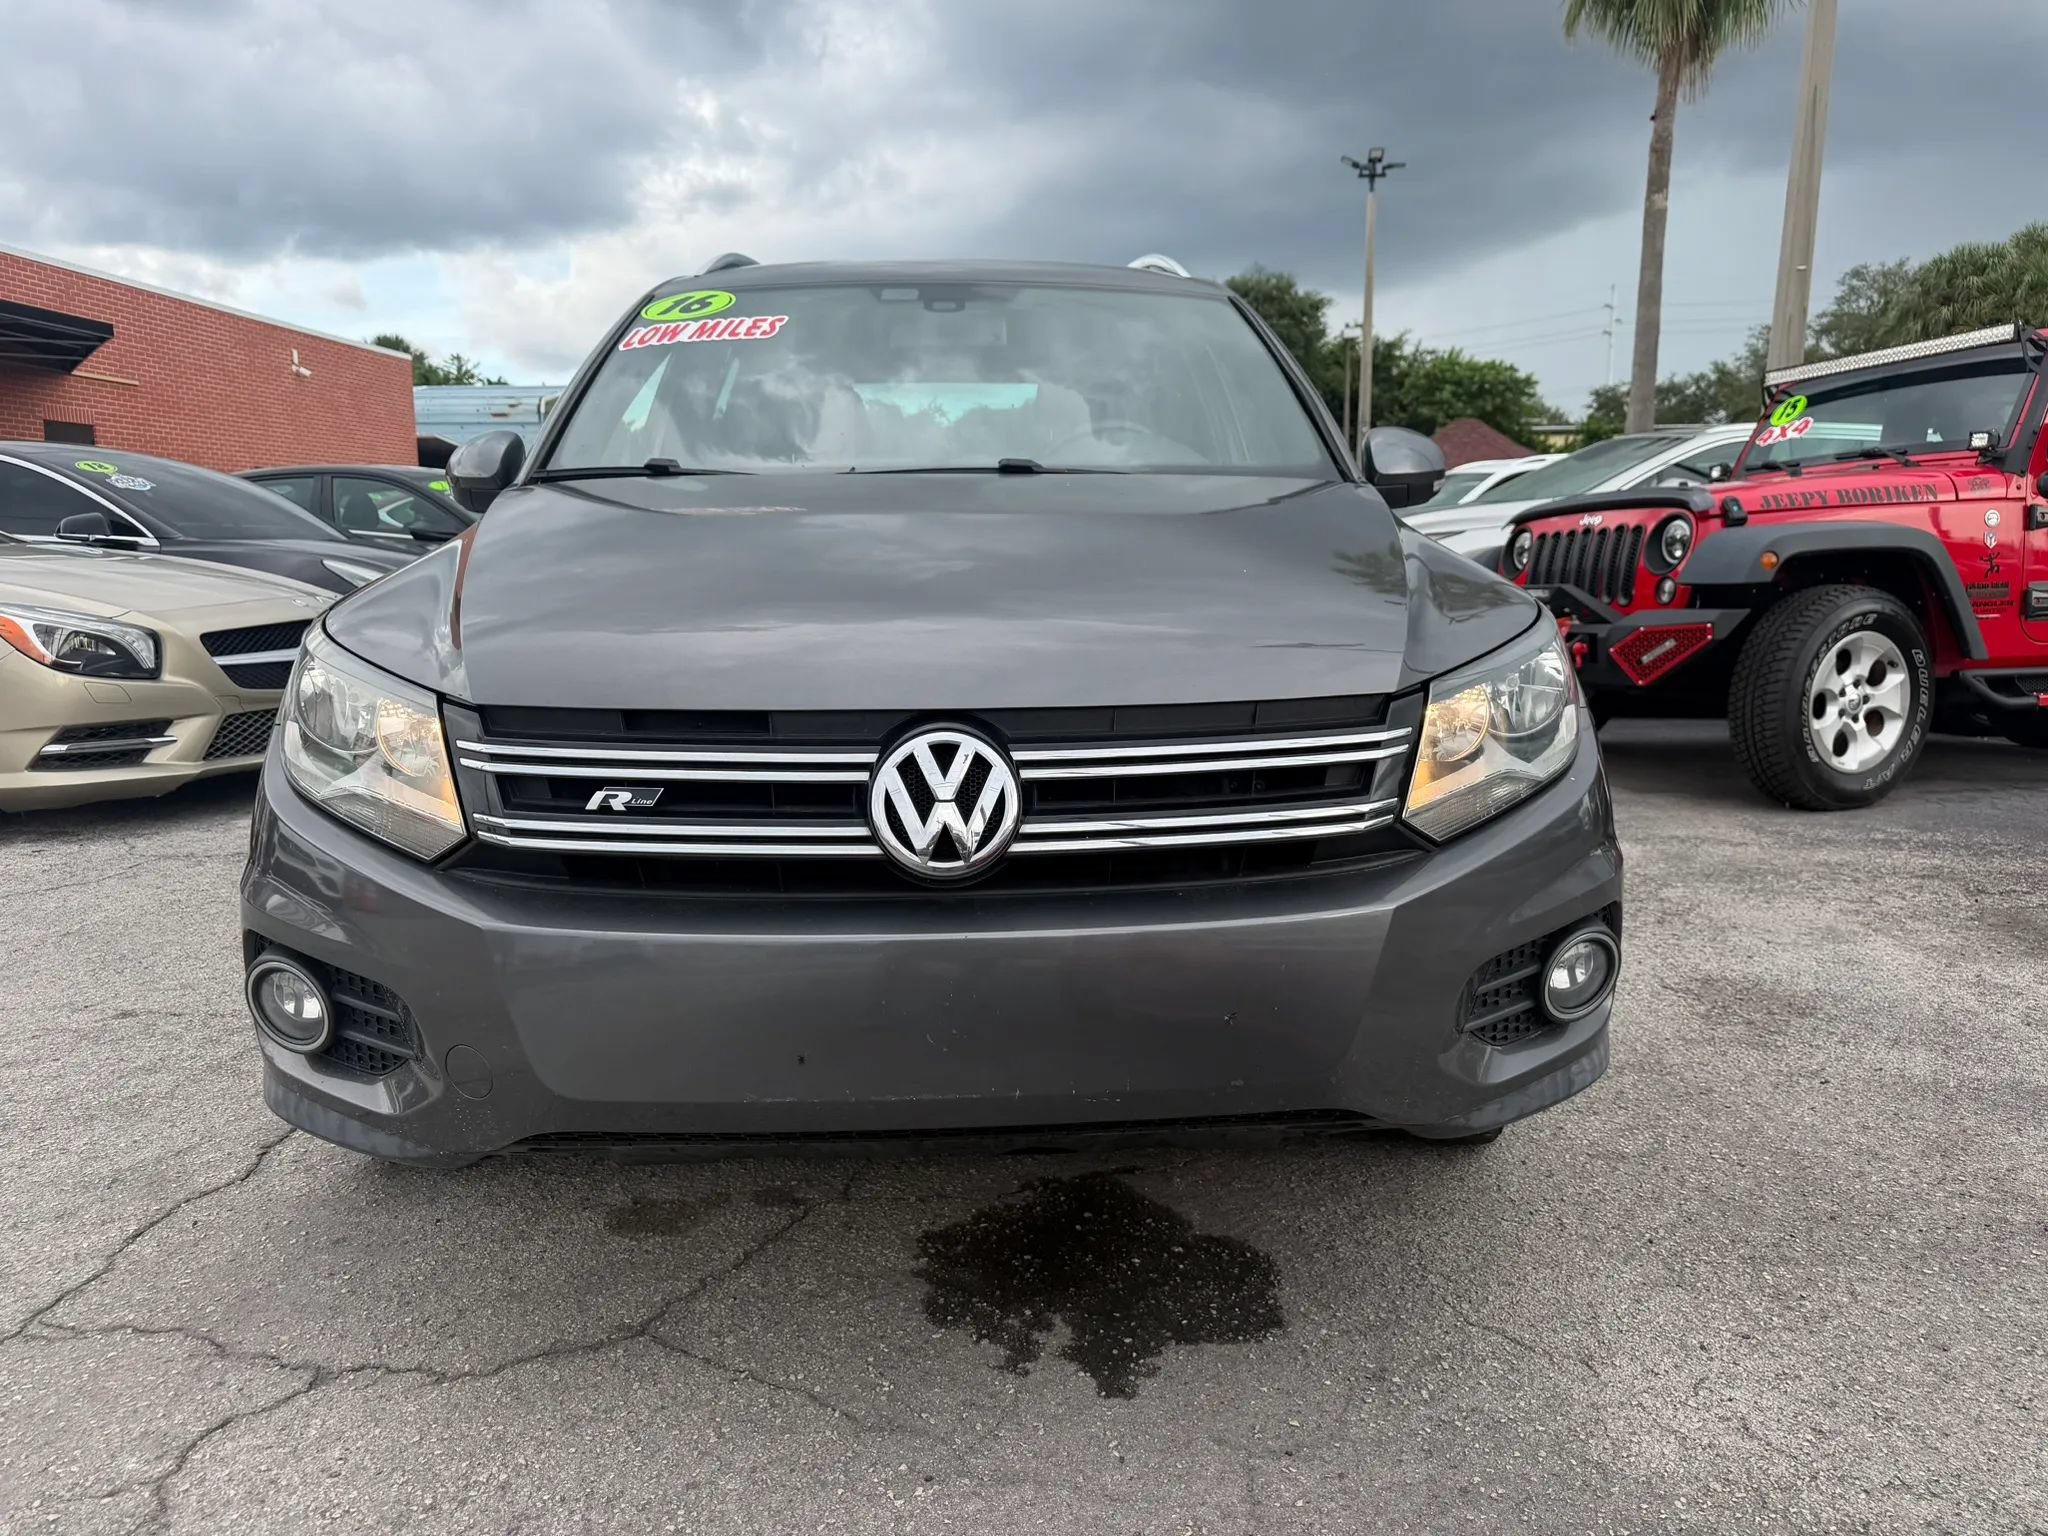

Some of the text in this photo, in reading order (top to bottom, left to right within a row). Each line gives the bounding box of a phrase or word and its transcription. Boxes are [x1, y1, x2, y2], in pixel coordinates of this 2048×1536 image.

[657, 294, 720, 316] 16
[620, 316, 787, 350] LOW MILES
[1776, 397, 1803, 421] 15
[1760, 483, 1938, 511] JEEPY BORIKEN
[1579, 513, 1603, 526] Jeep
[584, 790, 653, 811] R Line
